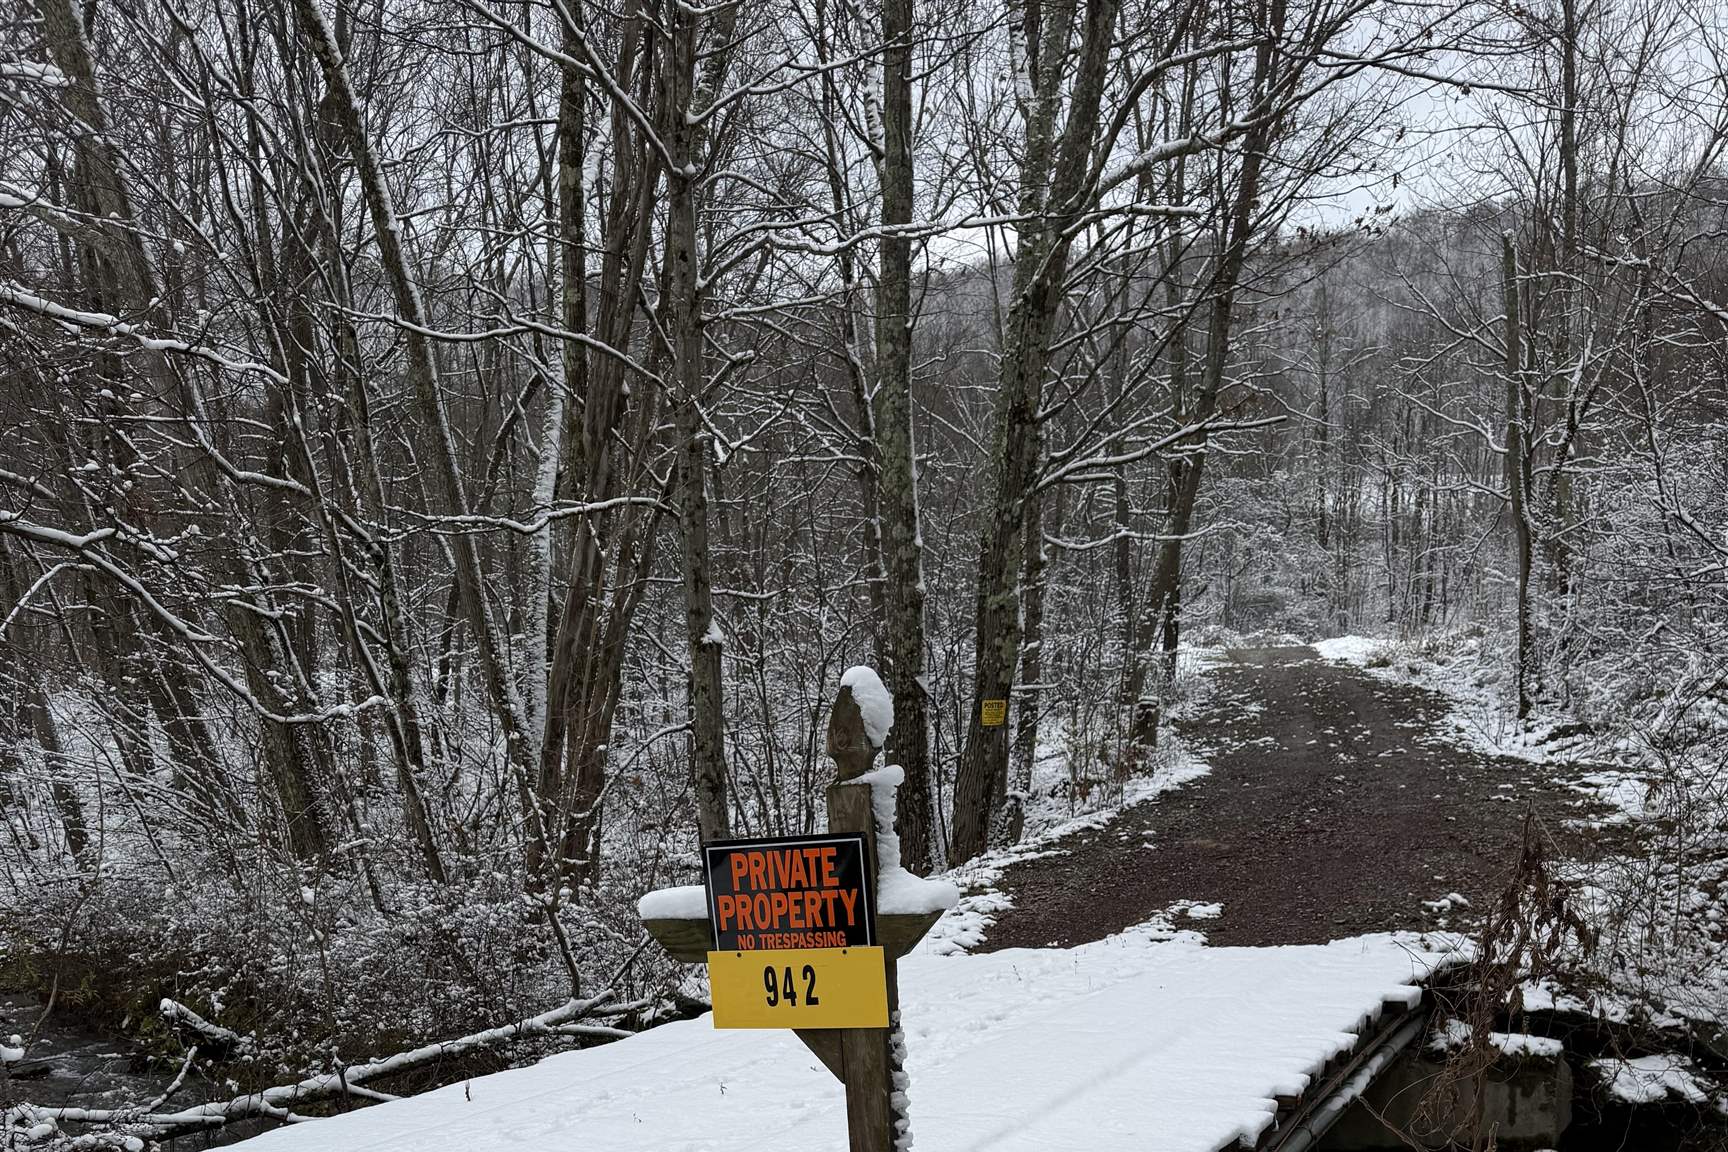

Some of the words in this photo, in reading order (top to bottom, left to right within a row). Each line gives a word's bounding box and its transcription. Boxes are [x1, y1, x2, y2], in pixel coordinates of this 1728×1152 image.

[729, 847, 840, 891] PRIVATE
[717, 888, 858, 931] PROPERTY
[737, 934, 755, 950] NO
[759, 930, 847, 950] TRESPASSING
[763, 964, 819, 1007] 942
